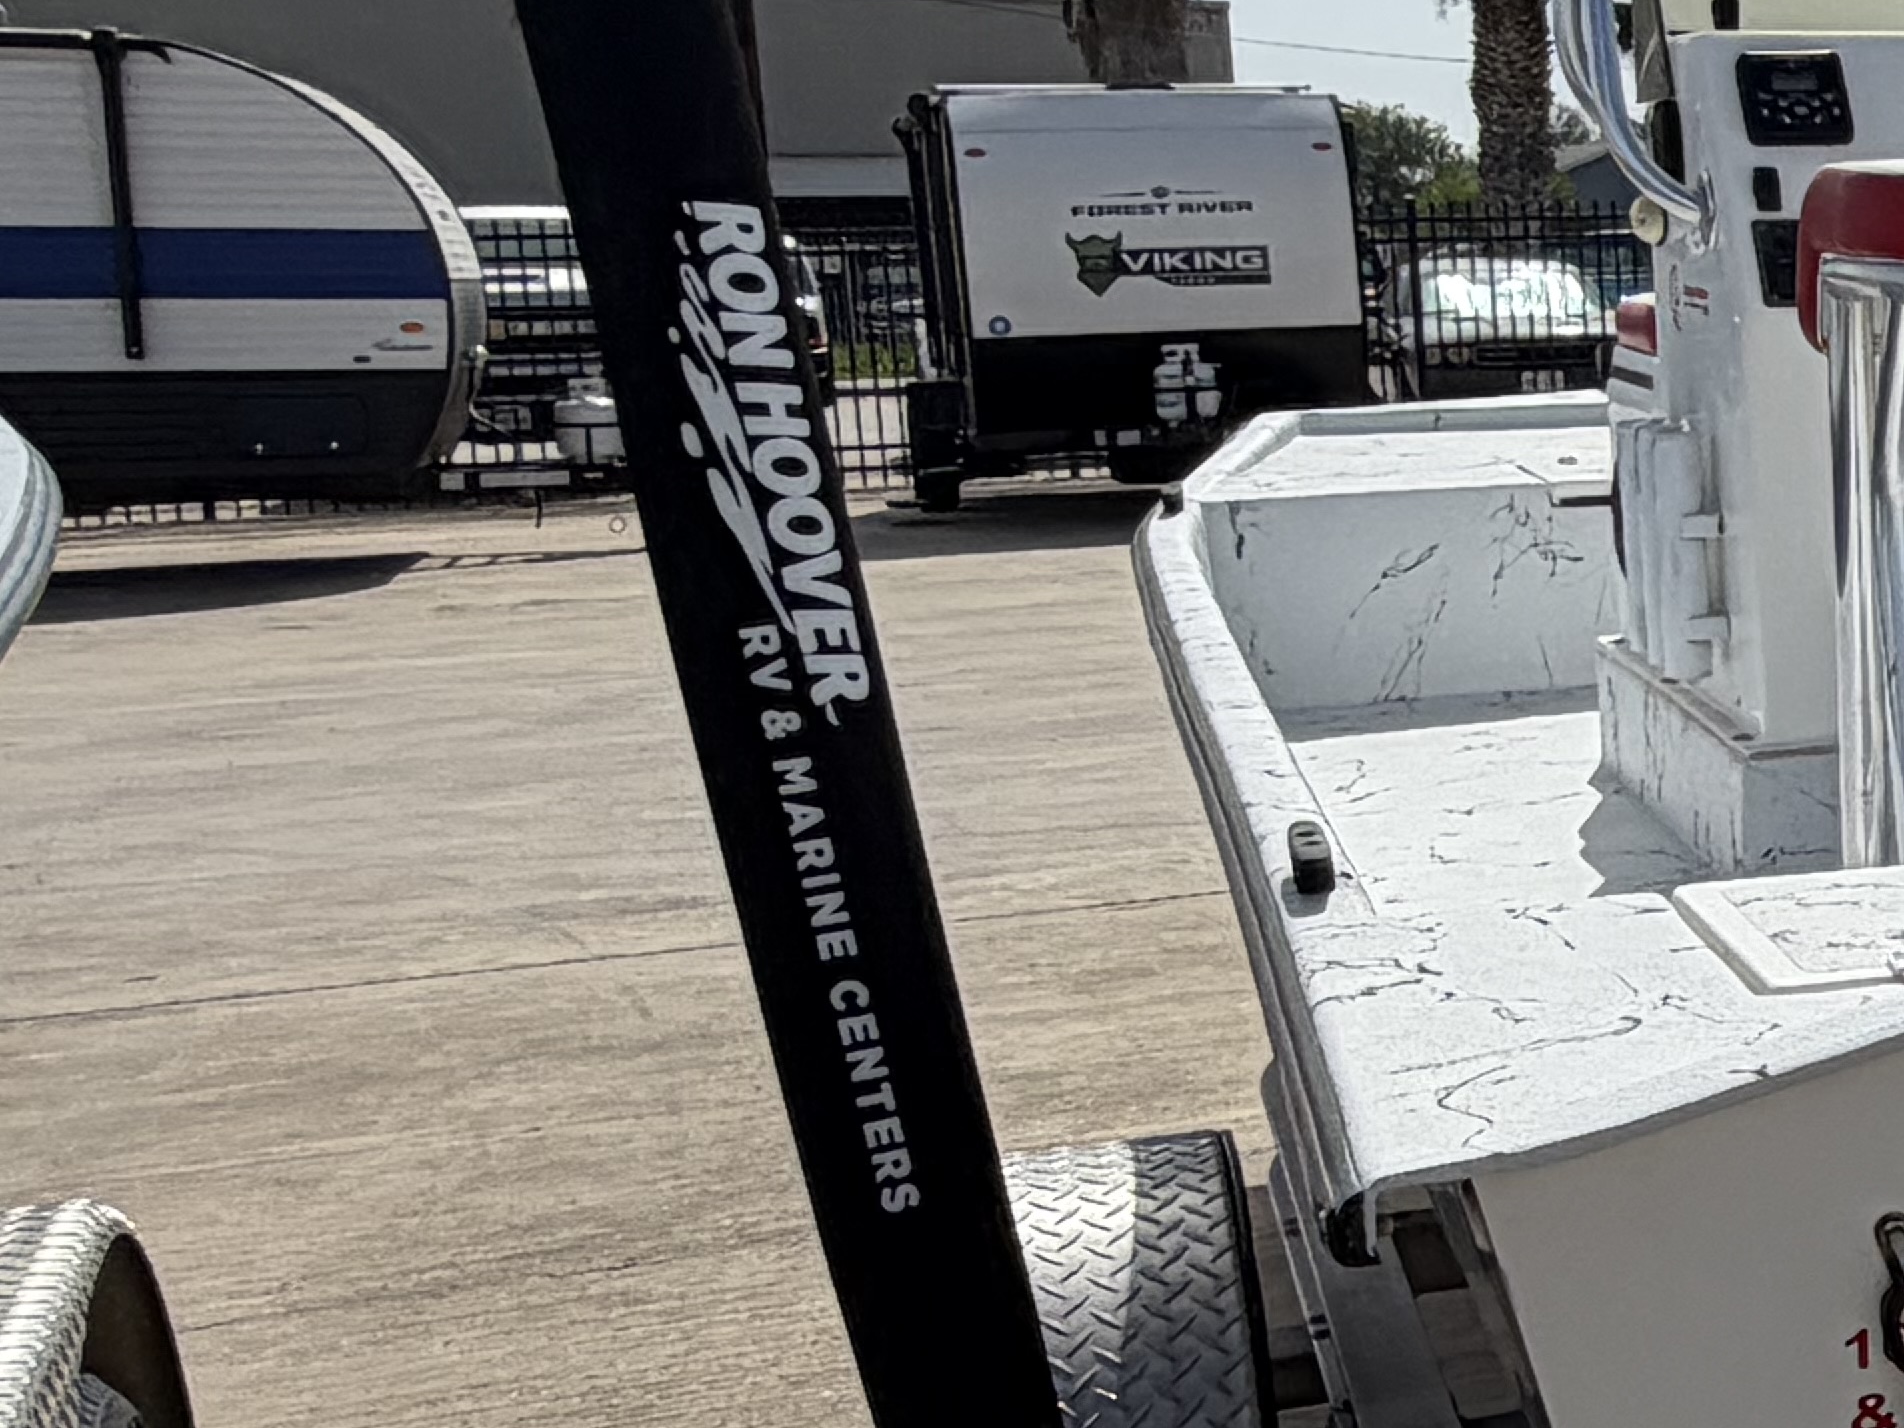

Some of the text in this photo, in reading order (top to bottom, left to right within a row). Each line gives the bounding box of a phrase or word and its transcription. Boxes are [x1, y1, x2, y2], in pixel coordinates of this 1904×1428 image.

[1070, 200, 1254, 218] FOREST RIVER
[1120, 249, 1264, 272] VIKING
[682, 200, 871, 727] RON HOOVER
[737, 624, 921, 1214] RV & MARINE CENTERS
